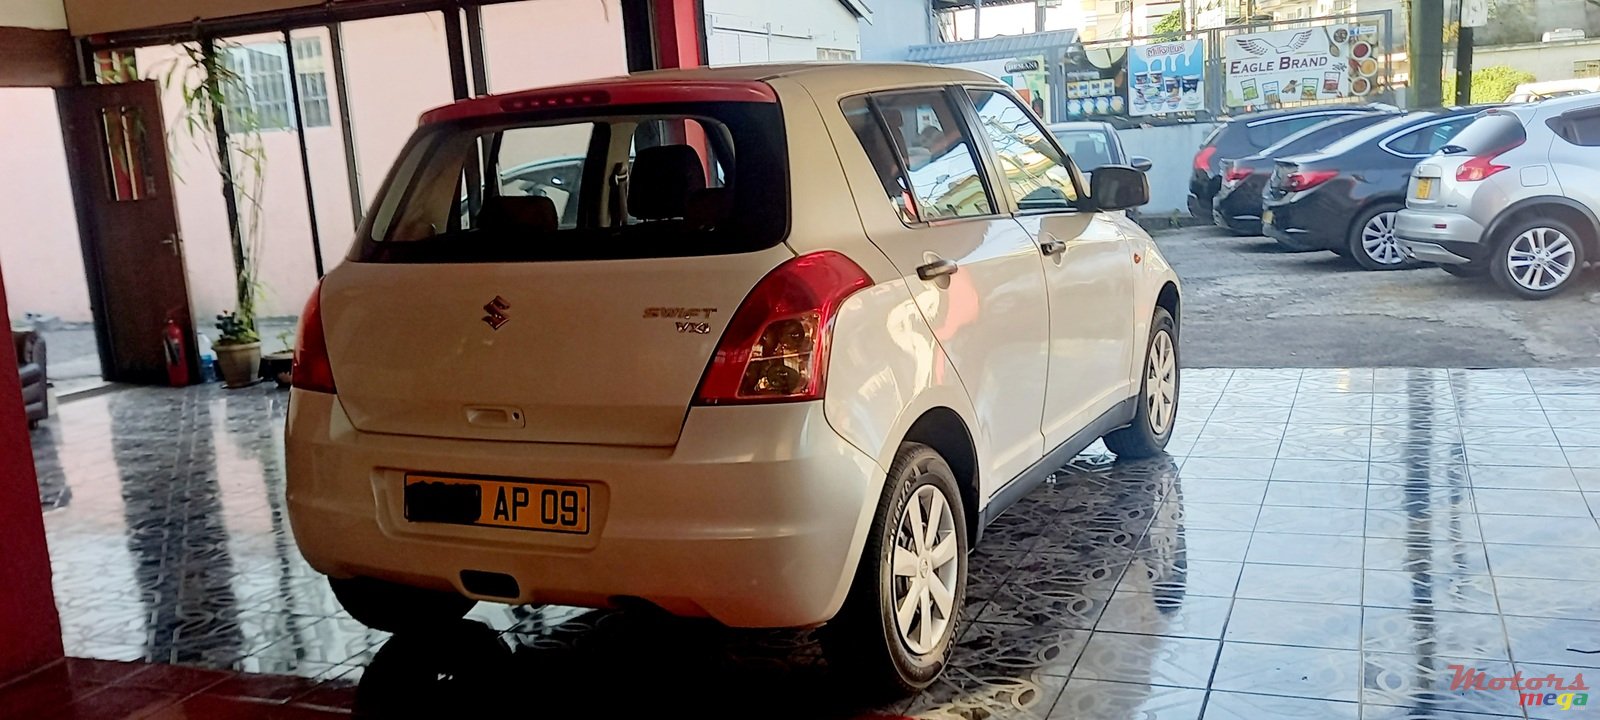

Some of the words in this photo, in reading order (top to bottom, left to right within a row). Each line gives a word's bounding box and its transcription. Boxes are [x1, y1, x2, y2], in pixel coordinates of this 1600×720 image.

[1230, 60, 1275, 75] EAGLE
[1279, 56, 1328, 70] BRAND
[642, 306, 718, 320] SWIFT
[493, 485, 529, 522] AP
[541, 488, 578, 527] 09
